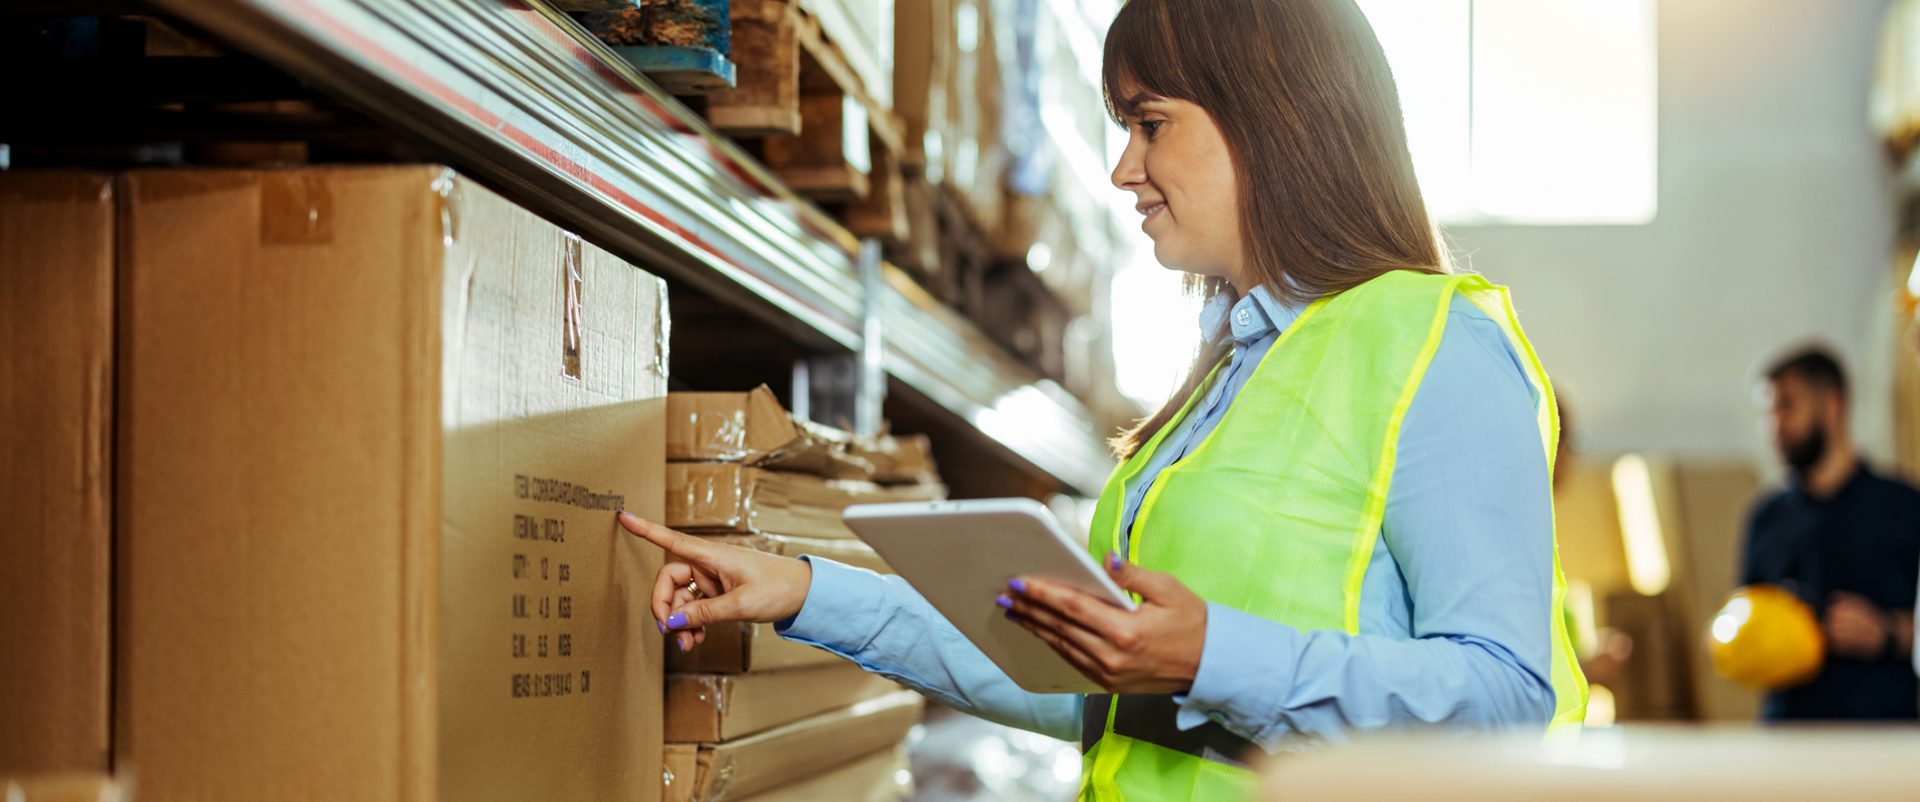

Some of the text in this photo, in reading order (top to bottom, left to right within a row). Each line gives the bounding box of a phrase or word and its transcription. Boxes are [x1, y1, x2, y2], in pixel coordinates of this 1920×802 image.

[540, 557, 549, 580] 12
[559, 564, 570, 587] pcs
[559, 596, 571, 619] KGS
[559, 633, 571, 657] KGS
[581, 670, 590, 694] CM
